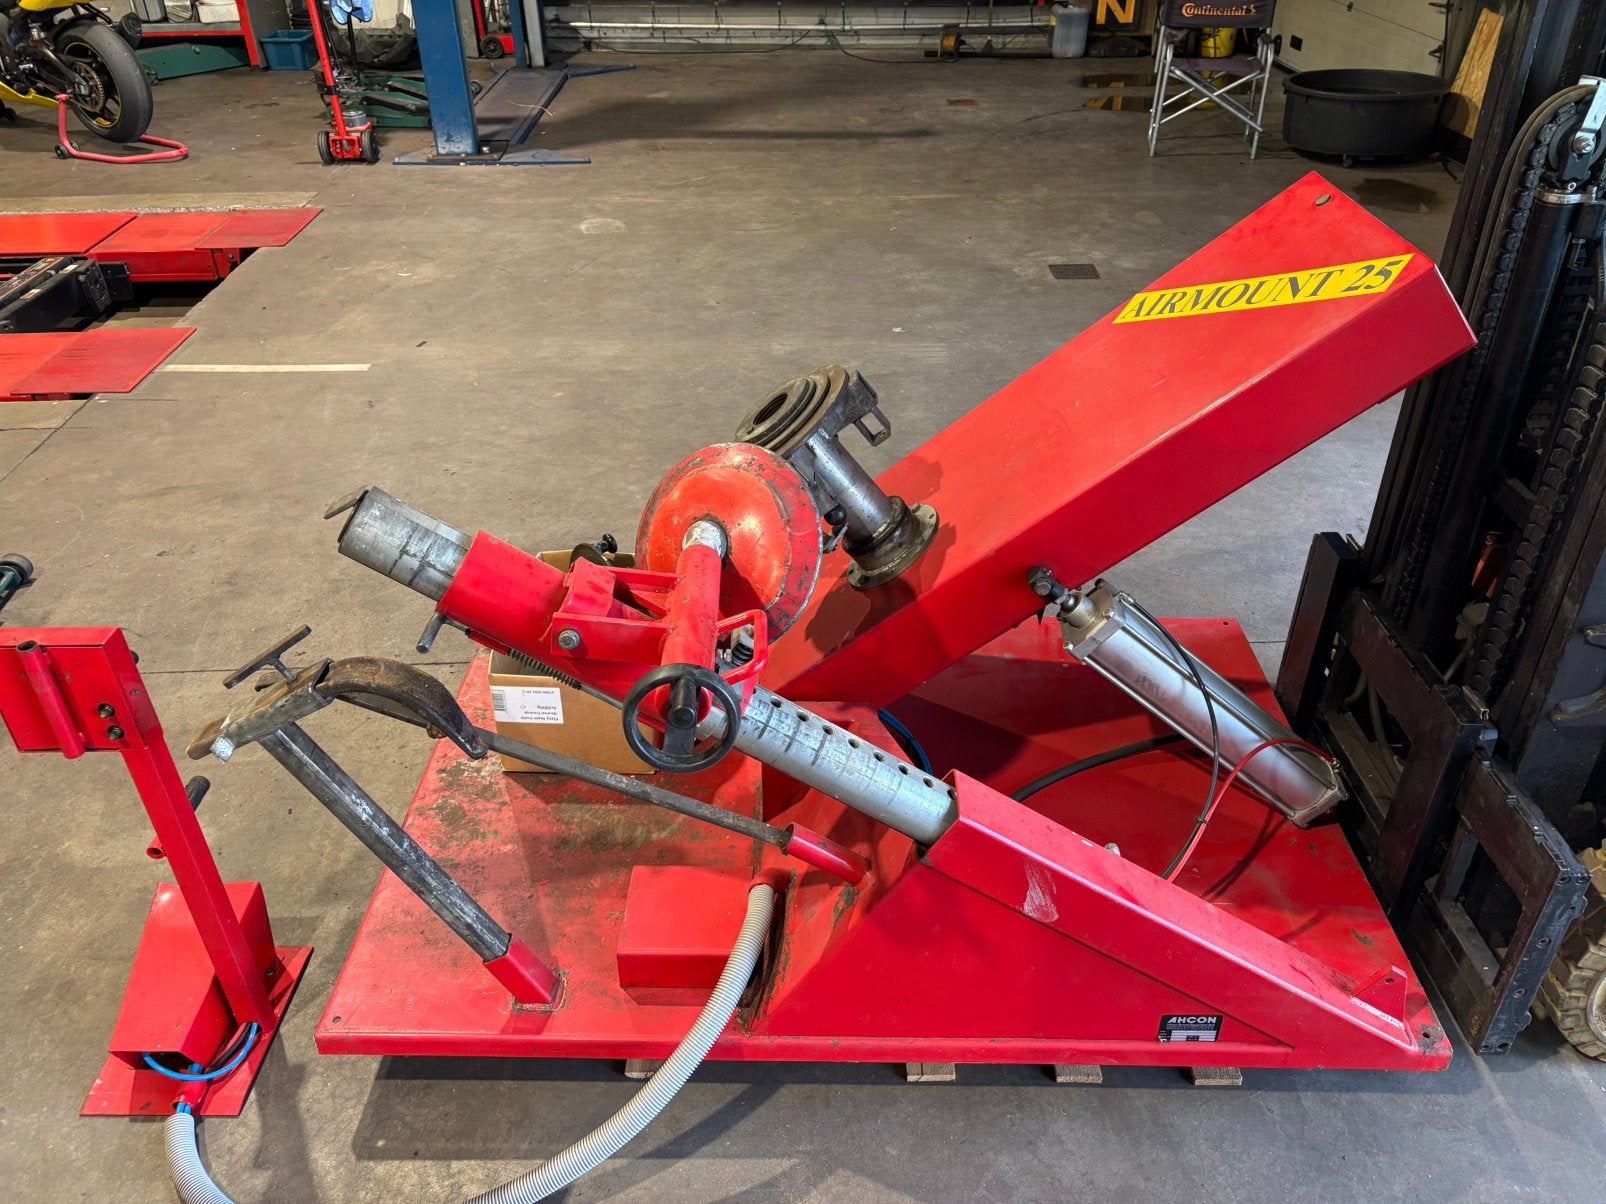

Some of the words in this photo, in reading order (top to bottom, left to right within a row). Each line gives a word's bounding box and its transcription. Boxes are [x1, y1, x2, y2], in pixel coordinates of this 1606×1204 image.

[1182, 2, 1247, 18] Continental
[1120, 268, 1345, 320] AIRMOUNT
[1340, 259, 1404, 294] 25
[1167, 1016, 1217, 1024] AHCON
